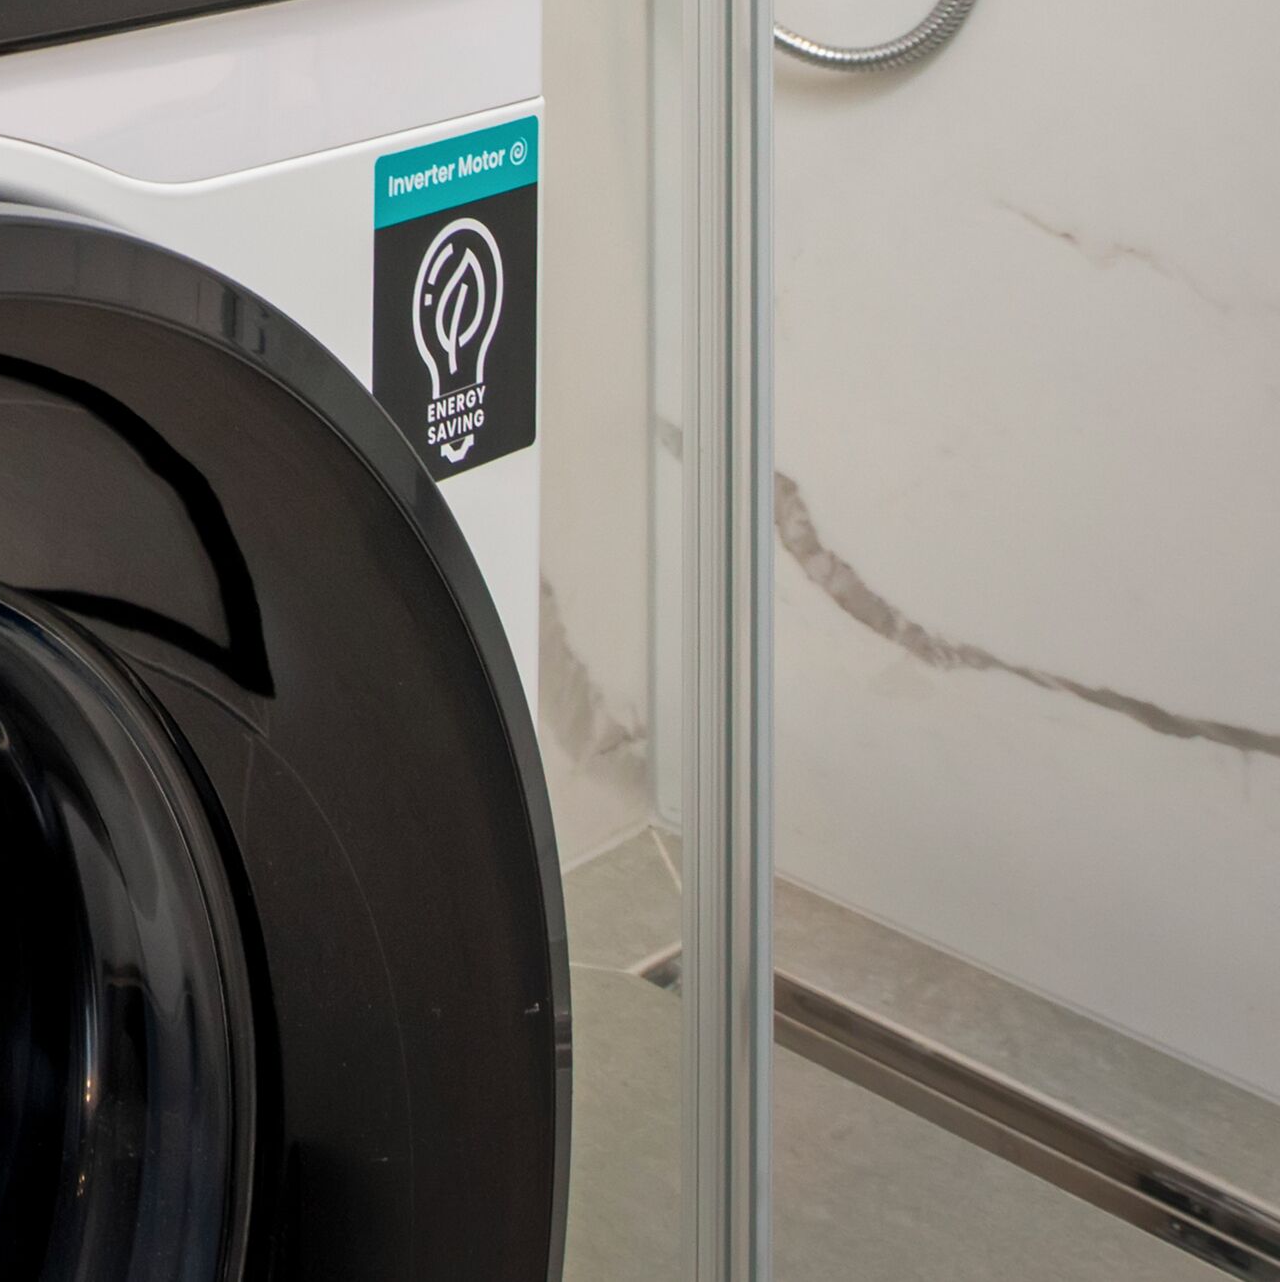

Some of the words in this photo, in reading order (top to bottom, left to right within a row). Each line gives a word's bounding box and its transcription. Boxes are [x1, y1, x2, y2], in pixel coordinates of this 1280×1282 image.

[388, 161, 456, 198] Inverter
[457, 147, 506, 179] Motor
[427, 385, 487, 422] ENERGY
[427, 408, 485, 446] SAVING
